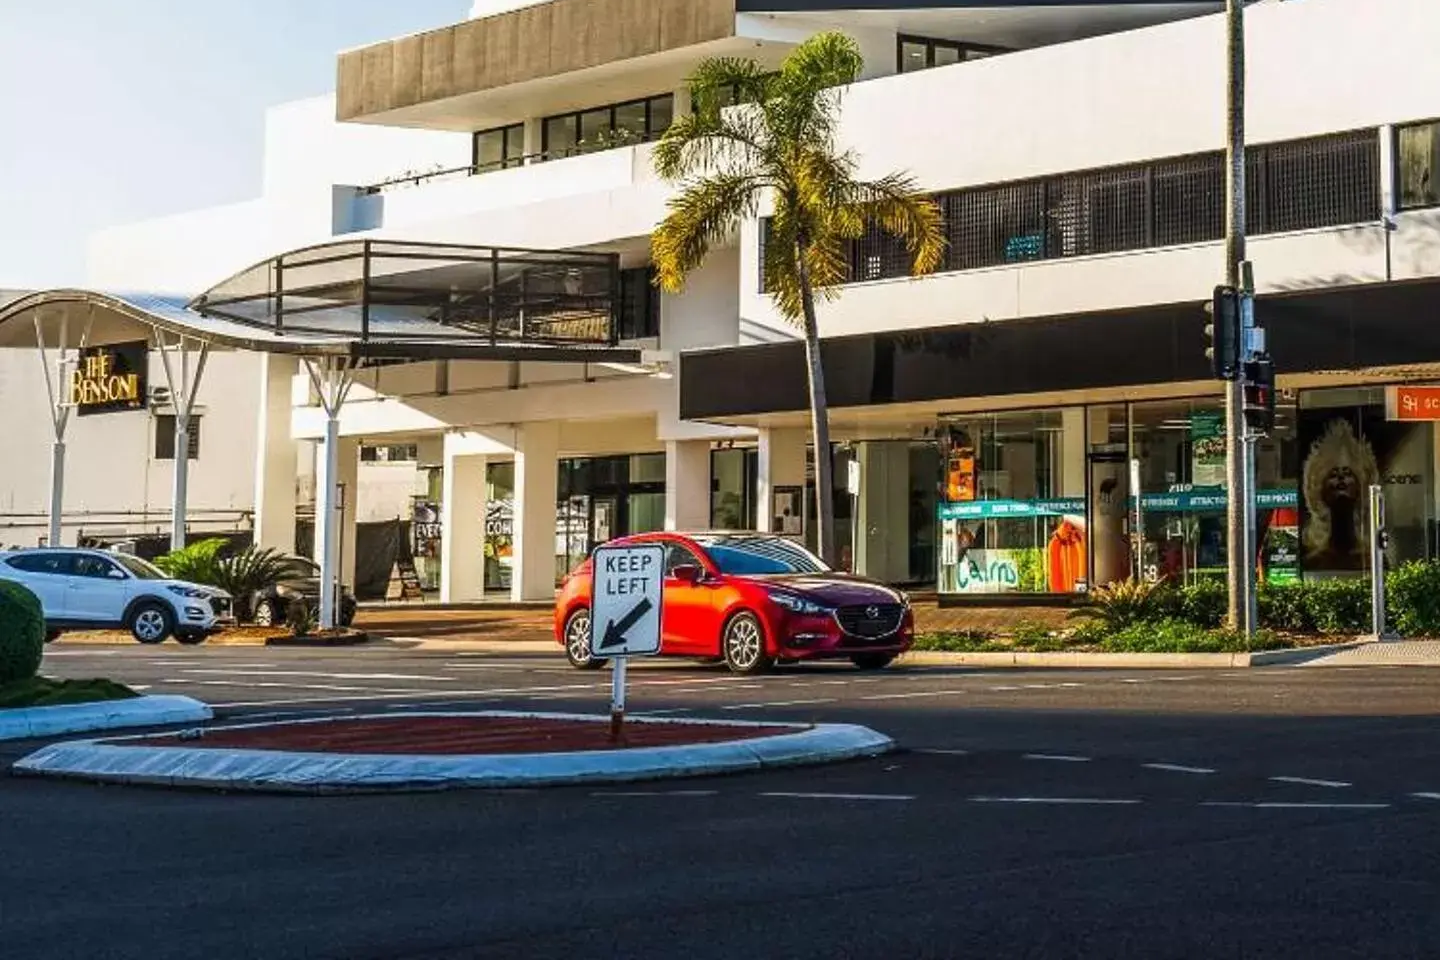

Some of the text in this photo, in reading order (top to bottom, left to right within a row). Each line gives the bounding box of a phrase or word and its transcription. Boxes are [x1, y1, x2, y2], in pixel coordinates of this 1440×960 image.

[85, 354, 109, 379] THE
[606, 554, 652, 572] KEEP
[958, 559, 1016, 589] Cairns
[607, 577, 650, 595] LEFT
